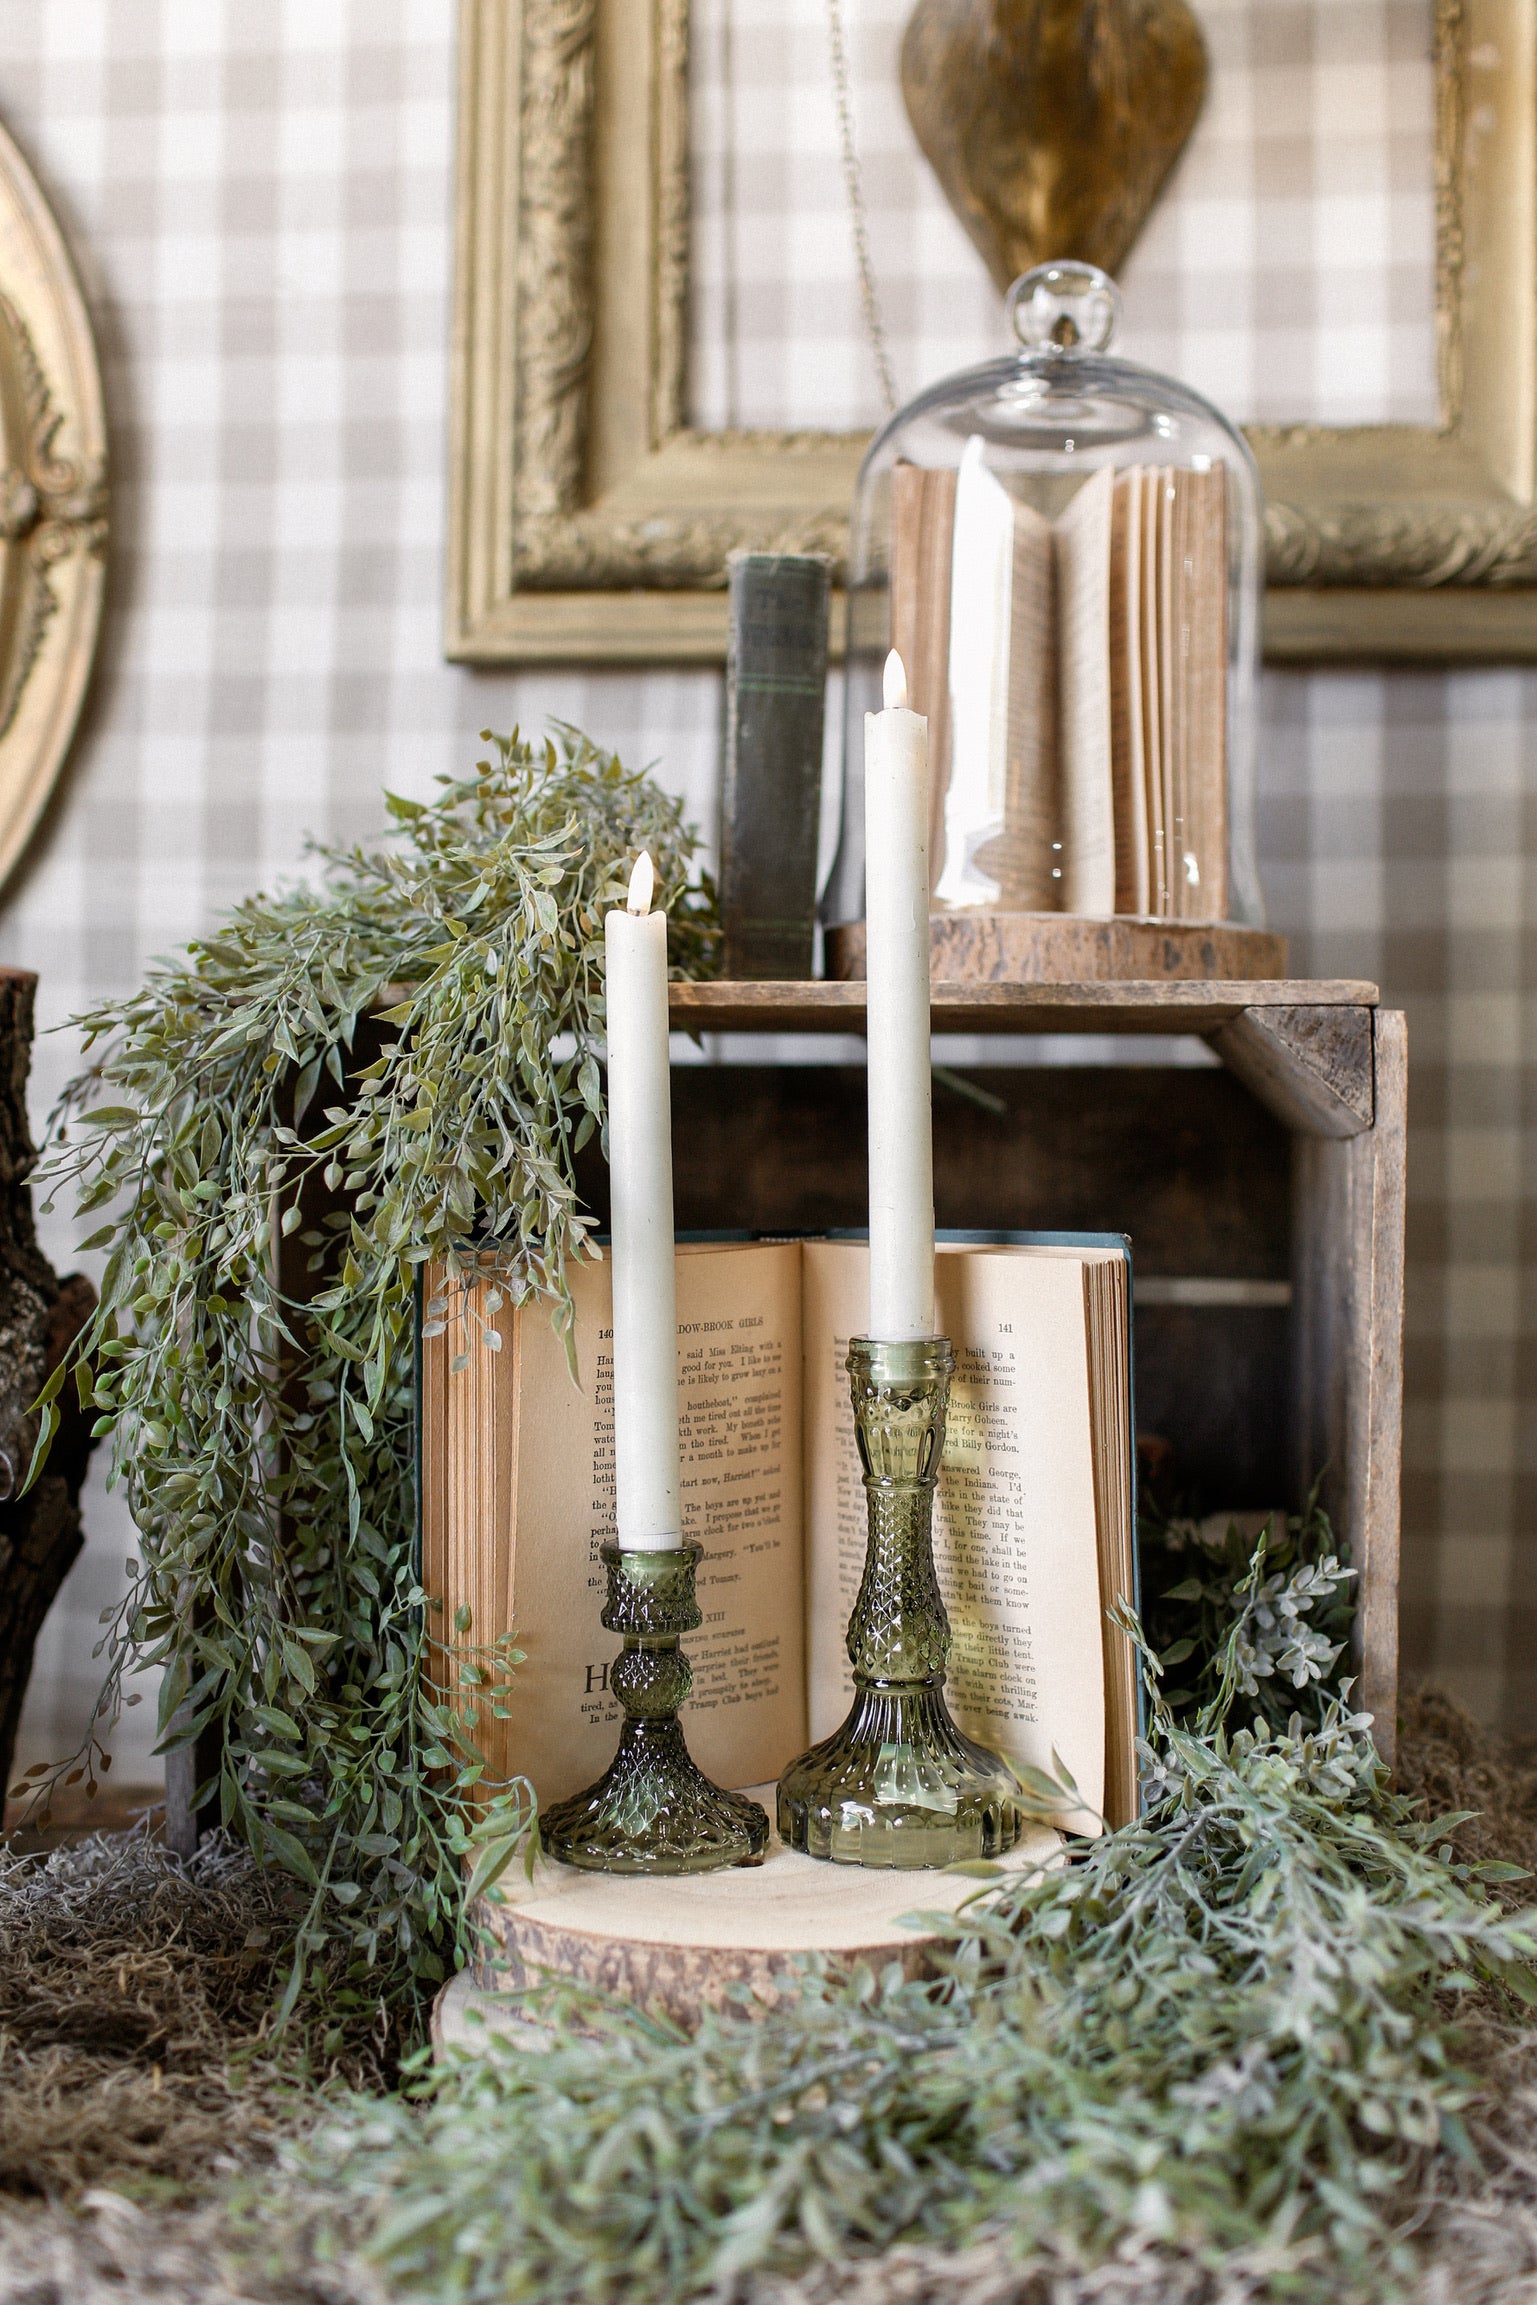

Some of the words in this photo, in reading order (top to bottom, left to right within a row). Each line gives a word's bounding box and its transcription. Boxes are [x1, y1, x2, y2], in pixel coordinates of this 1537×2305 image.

[676, 1320, 733, 1334] DOW-BROOK
[739, 1316, 763, 1328] GIRLS
[999, 1324, 1013, 1333] 141
[599, 1330, 613, 1339] 140
[687, 1350, 703, 1359] said
[709, 1348, 725, 1357] Miss
[966, 1350, 985, 1358] built
[992, 1351, 1003, 1362] up
[682, 1364, 700, 1374] good
[704, 1360, 716, 1370] for
[741, 1358, 745, 1366] I
[962, 1363, 990, 1372] cooked
[994, 1365, 1015, 1373] some
[596, 1383, 612, 1393] you
[688, 1376, 695, 1385] is
[698, 1373, 719, 1385] likely
[722, 1372, 729, 1381] to
[732, 1370, 749, 1382] grow
[958, 1375, 967, 1383] of
[970, 1375, 990, 1385] their
[993, 1377, 1016, 1387] num-
[979, 1402, 999, 1413] Girls
[1003, 1405, 1017, 1413] are
[694, 1415, 706, 1423] me
[709, 1409, 726, 1420] tired
[948, 1412, 972, 1424] Larry
[974, 1414, 1008, 1426] Goheen.
[696, 1426, 718, 1435] work.
[726, 1422, 737, 1433] My
[962, 1427, 975, 1436] for
[594, 1448, 604, 1458] all
[691, 1440, 704, 1450] tho
[709, 1435, 728, 1446] tired.
[742, 1432, 760, 1441] When
[962, 1439, 982, 1450] Billy
[985, 1441, 1019, 1453] Gordon,
[698, 1449, 723, 1461] month
[727, 1448, 734, 1456] to
[942, 1465, 980, 1474] answered
[702, 1475, 720, 1486] now,
[946, 1477, 959, 1486] the
[965, 1478, 998, 1490] Indians.
[936, 1489, 955, 1498] girls
[960, 1491, 968, 1499] in
[972, 1491, 985, 1500] the
[989, 1495, 1010, 1504] state
[1014, 1496, 1023, 1505] of
[592, 1501, 606, 1510] the
[685, 1504, 700, 1513] The
[706, 1502, 723, 1514] boys
[727, 1499, 738, 1507] are
[941, 1502, 960, 1512] hike
[964, 1504, 983, 1515] they
[987, 1507, 1001, 1516] did
[1006, 1509, 1023, 1518] that
[706, 1513, 710, 1522] I
[744, 1507, 759, 1517] that
[704, 1525, 724, 1536] clock
[728, 1522, 738, 1532] for
[936, 1515, 957, 1524] trail.
[966, 1516, 988, 1528] They
[992, 1521, 1010, 1531] may
[1015, 1522, 1024, 1532] be
[934, 1526, 944, 1536] by
[949, 1528, 966, 1537] this
[970, 1530, 991, 1540] time.
[1000, 1533, 1008, 1542] If
[1014, 1536, 1025, 1544] we
[591, 1538, 599, 1548] to
[944, 1540, 950, 1549] I,
[954, 1541, 967, 1550] for
[971, 1544, 988, 1555] one,
[992, 1545, 1012, 1556] shall
[1016, 1548, 1026, 1558] be
[590, 1552, 598, 1561] in
[966, 1555, 979, 1564] the
[982, 1556, 1000, 1567] lake
[1002, 1559, 1010, 1568] in
[1013, 1560, 1027, 1570] the
[936, 1564, 953, 1574] that
[957, 1568, 968, 1576] we
[972, 1568, 988, 1579] had
[991, 1571, 1000, 1580] to
[1004, 1574, 1013, 1583] go
[1017, 1575, 1028, 1583] on
[588, 1577, 602, 1587] the
[968, 1580, 985, 1590] bait
[990, 1584, 999, 1593] or
[1004, 1585, 1029, 1596] some-
[966, 1593, 976, 1603] let
[981, 1596, 1002, 1606] them
[1006, 1598, 1029, 1609] know
[706, 1612, 725, 1624] XIII
[962, 1617, 976, 1626] the
[980, 1621, 999, 1633] boys
[1002, 1623, 1031, 1634] turned
[977, 1632, 1009, 1646] directly
[1013, 1636, 1032, 1648] they
[702, 1648, 731, 1659] Harriet
[964, 1642, 984, 1653] their
[988, 1646, 1010, 1657] little
[1014, 1649, 1034, 1660] tent.
[956, 1652, 984, 1666] Tramp
[988, 1658, 1009, 1668] Club
[1014, 1663, 1036, 1672] were
[956, 1665, 969, 1674] the
[972, 1668, 997, 1680] alarm
[1000, 1672, 1022, 1683] clock
[1026, 1677, 1036, 1685] on
[965, 1678, 984, 1689] with
[1001, 1684, 1038, 1699] thrilling
[581, 1700, 604, 1713] tired,
[970, 1690, 990, 1702] their
[994, 1696, 1014, 1708] cots,
[1018, 1699, 1038, 1710] Mar-
[590, 1715, 600, 1724] In
[605, 1711, 618, 1721] the
[986, 1705, 1010, 1719] being
